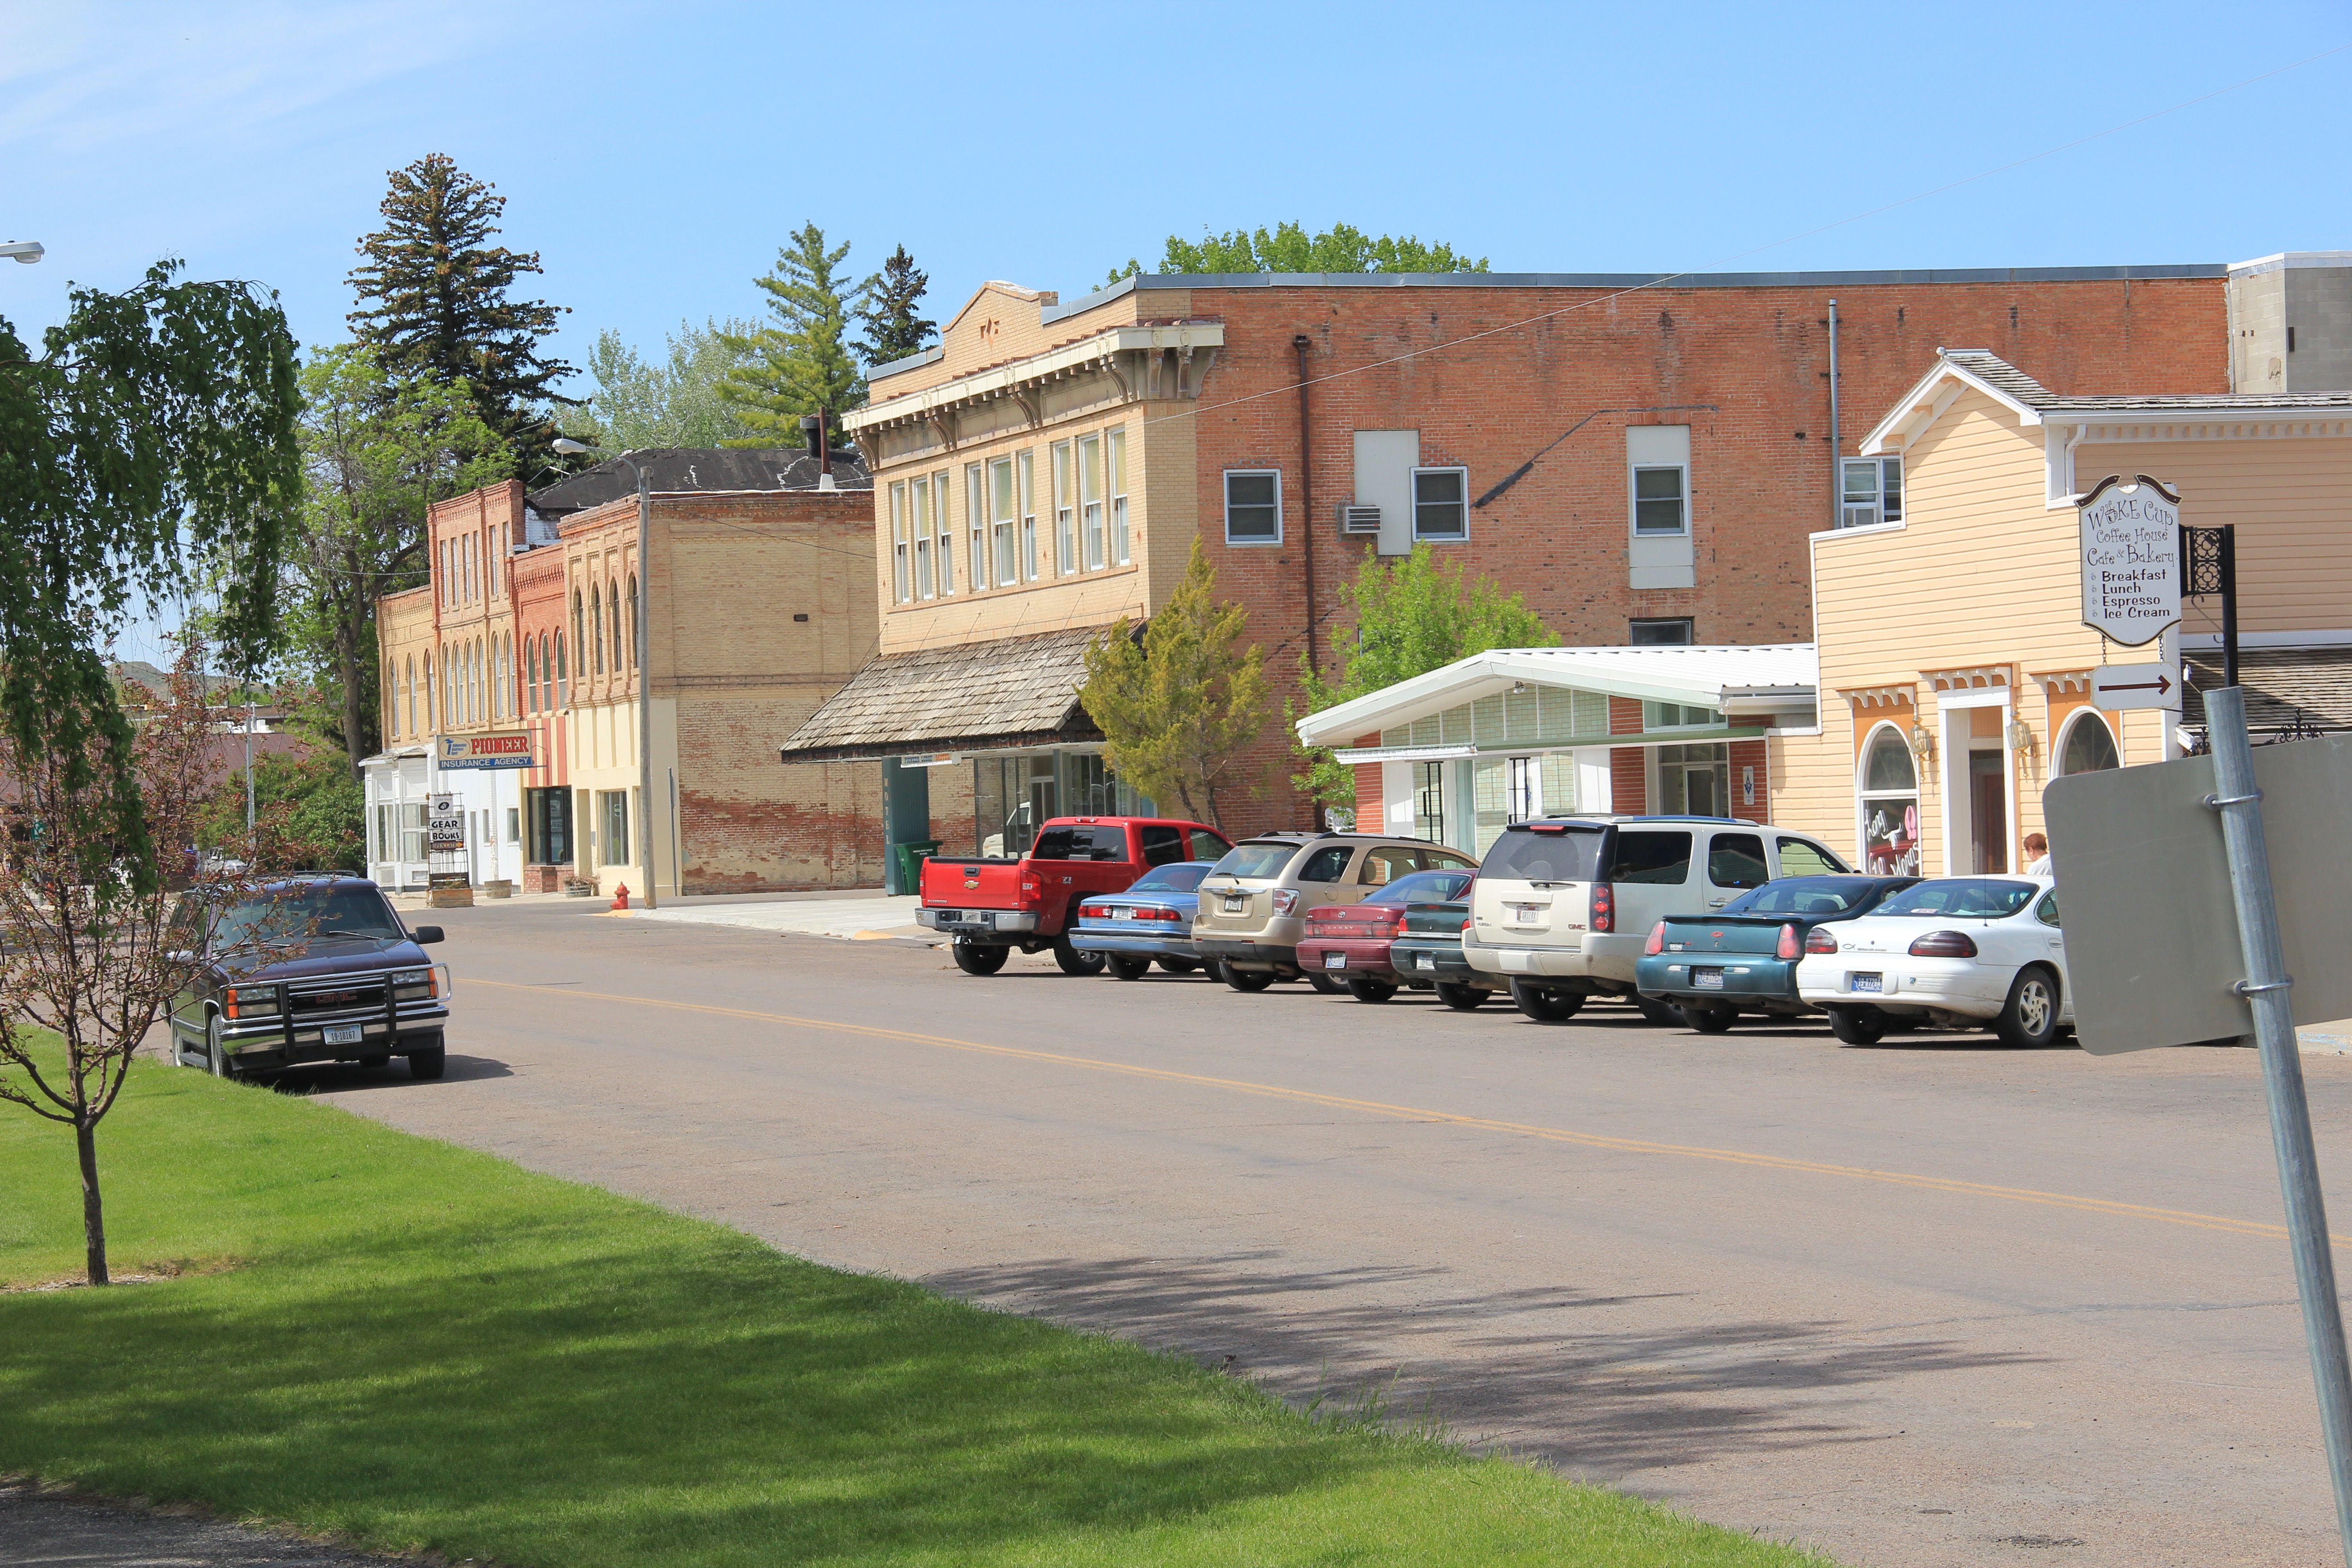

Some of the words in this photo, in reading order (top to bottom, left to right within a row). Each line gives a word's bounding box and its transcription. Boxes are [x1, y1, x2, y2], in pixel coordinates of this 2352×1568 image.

[2144, 500, 2173, 531] Cup
[2097, 528, 2131, 544] Coffee
[2134, 527, 2168, 544] House
[2087, 548, 2115, 566] Cafe
[2117, 549, 2124, 558] &
[2126, 543, 2174, 567] Bakery
[2102, 568, 2167, 582] Breakfast
[2102, 582, 2141, 594] Lunch
[2102, 596, 2160, 609] Espresso
[2104, 608, 2122, 619] Ice
[2127, 607, 2170, 618] Cream
[471, 736, 529, 755] PIONEER
[441, 759, 490, 768] INSURANCE
[494, 757, 529, 766] AGENCY
[432, 820, 458, 828] GEAR
[316, 990, 357, 1003] GMC
